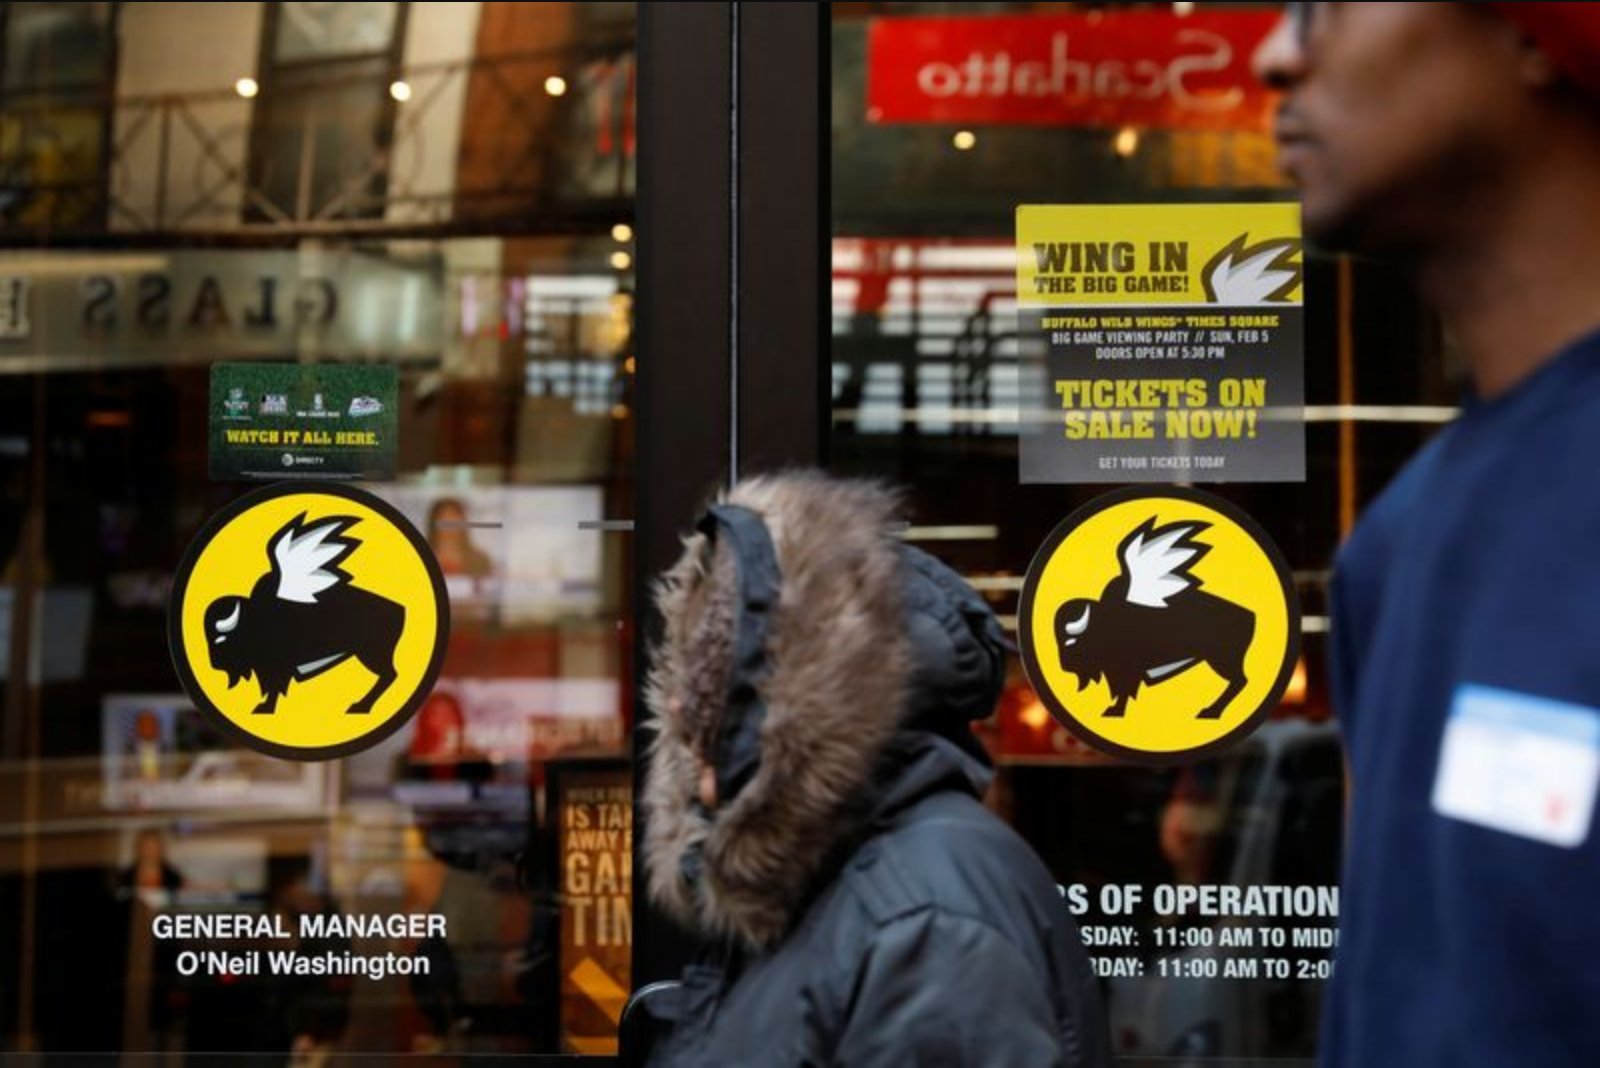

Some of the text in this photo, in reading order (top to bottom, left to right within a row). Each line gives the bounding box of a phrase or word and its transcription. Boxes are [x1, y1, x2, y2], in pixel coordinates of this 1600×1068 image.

[1034, 242, 1189, 273] WING IN
[1034, 275, 1189, 293] THE BIG GAME!
[1041, 317, 1097, 328] BUFFALO
[1100, 317, 1132, 328] WILD
[1186, 316, 1226, 327] TIMES
[1229, 315, 1279, 327] SQUARE
[1052, 332, 1071, 344] BIG
[1074, 332, 1103, 344] GAME
[1107, 331, 1151, 343] VIEWING
[1155, 331, 1189, 343] PARTY
[1209, 331, 1235, 344] SUN,
[1237, 330, 1259, 343] FEB
[1262, 330, 1269, 343] 5
[1096, 346, 1225, 359] DOORS OPEN AT 5:30 PM
[1055, 379, 1266, 408] TICKETS ON
[1065, 410, 1257, 439] SALE NOW!
[226, 430, 379, 445] WATCH IT ALL HERE.
[1099, 456, 1225, 469] GET YOUR TICKETS TODAY
[567, 804, 590, 829] IS
[567, 830, 619, 850] AWAY
[1100, 884, 1142, 915] OF
[152, 914, 447, 939] GENERAL MANAGER
[1080, 926, 1140, 946] SDAY:
[1153, 927, 1213, 947] 11:00
[1219, 927, 1251, 947] AM
[1258, 927, 1286, 947] TO
[176, 951, 430, 981] O'Neil Washington
[1157, 958, 1217, 978] 11:00
[1224, 958, 1257, 978] AM
[1264, 959, 1291, 979] TO
